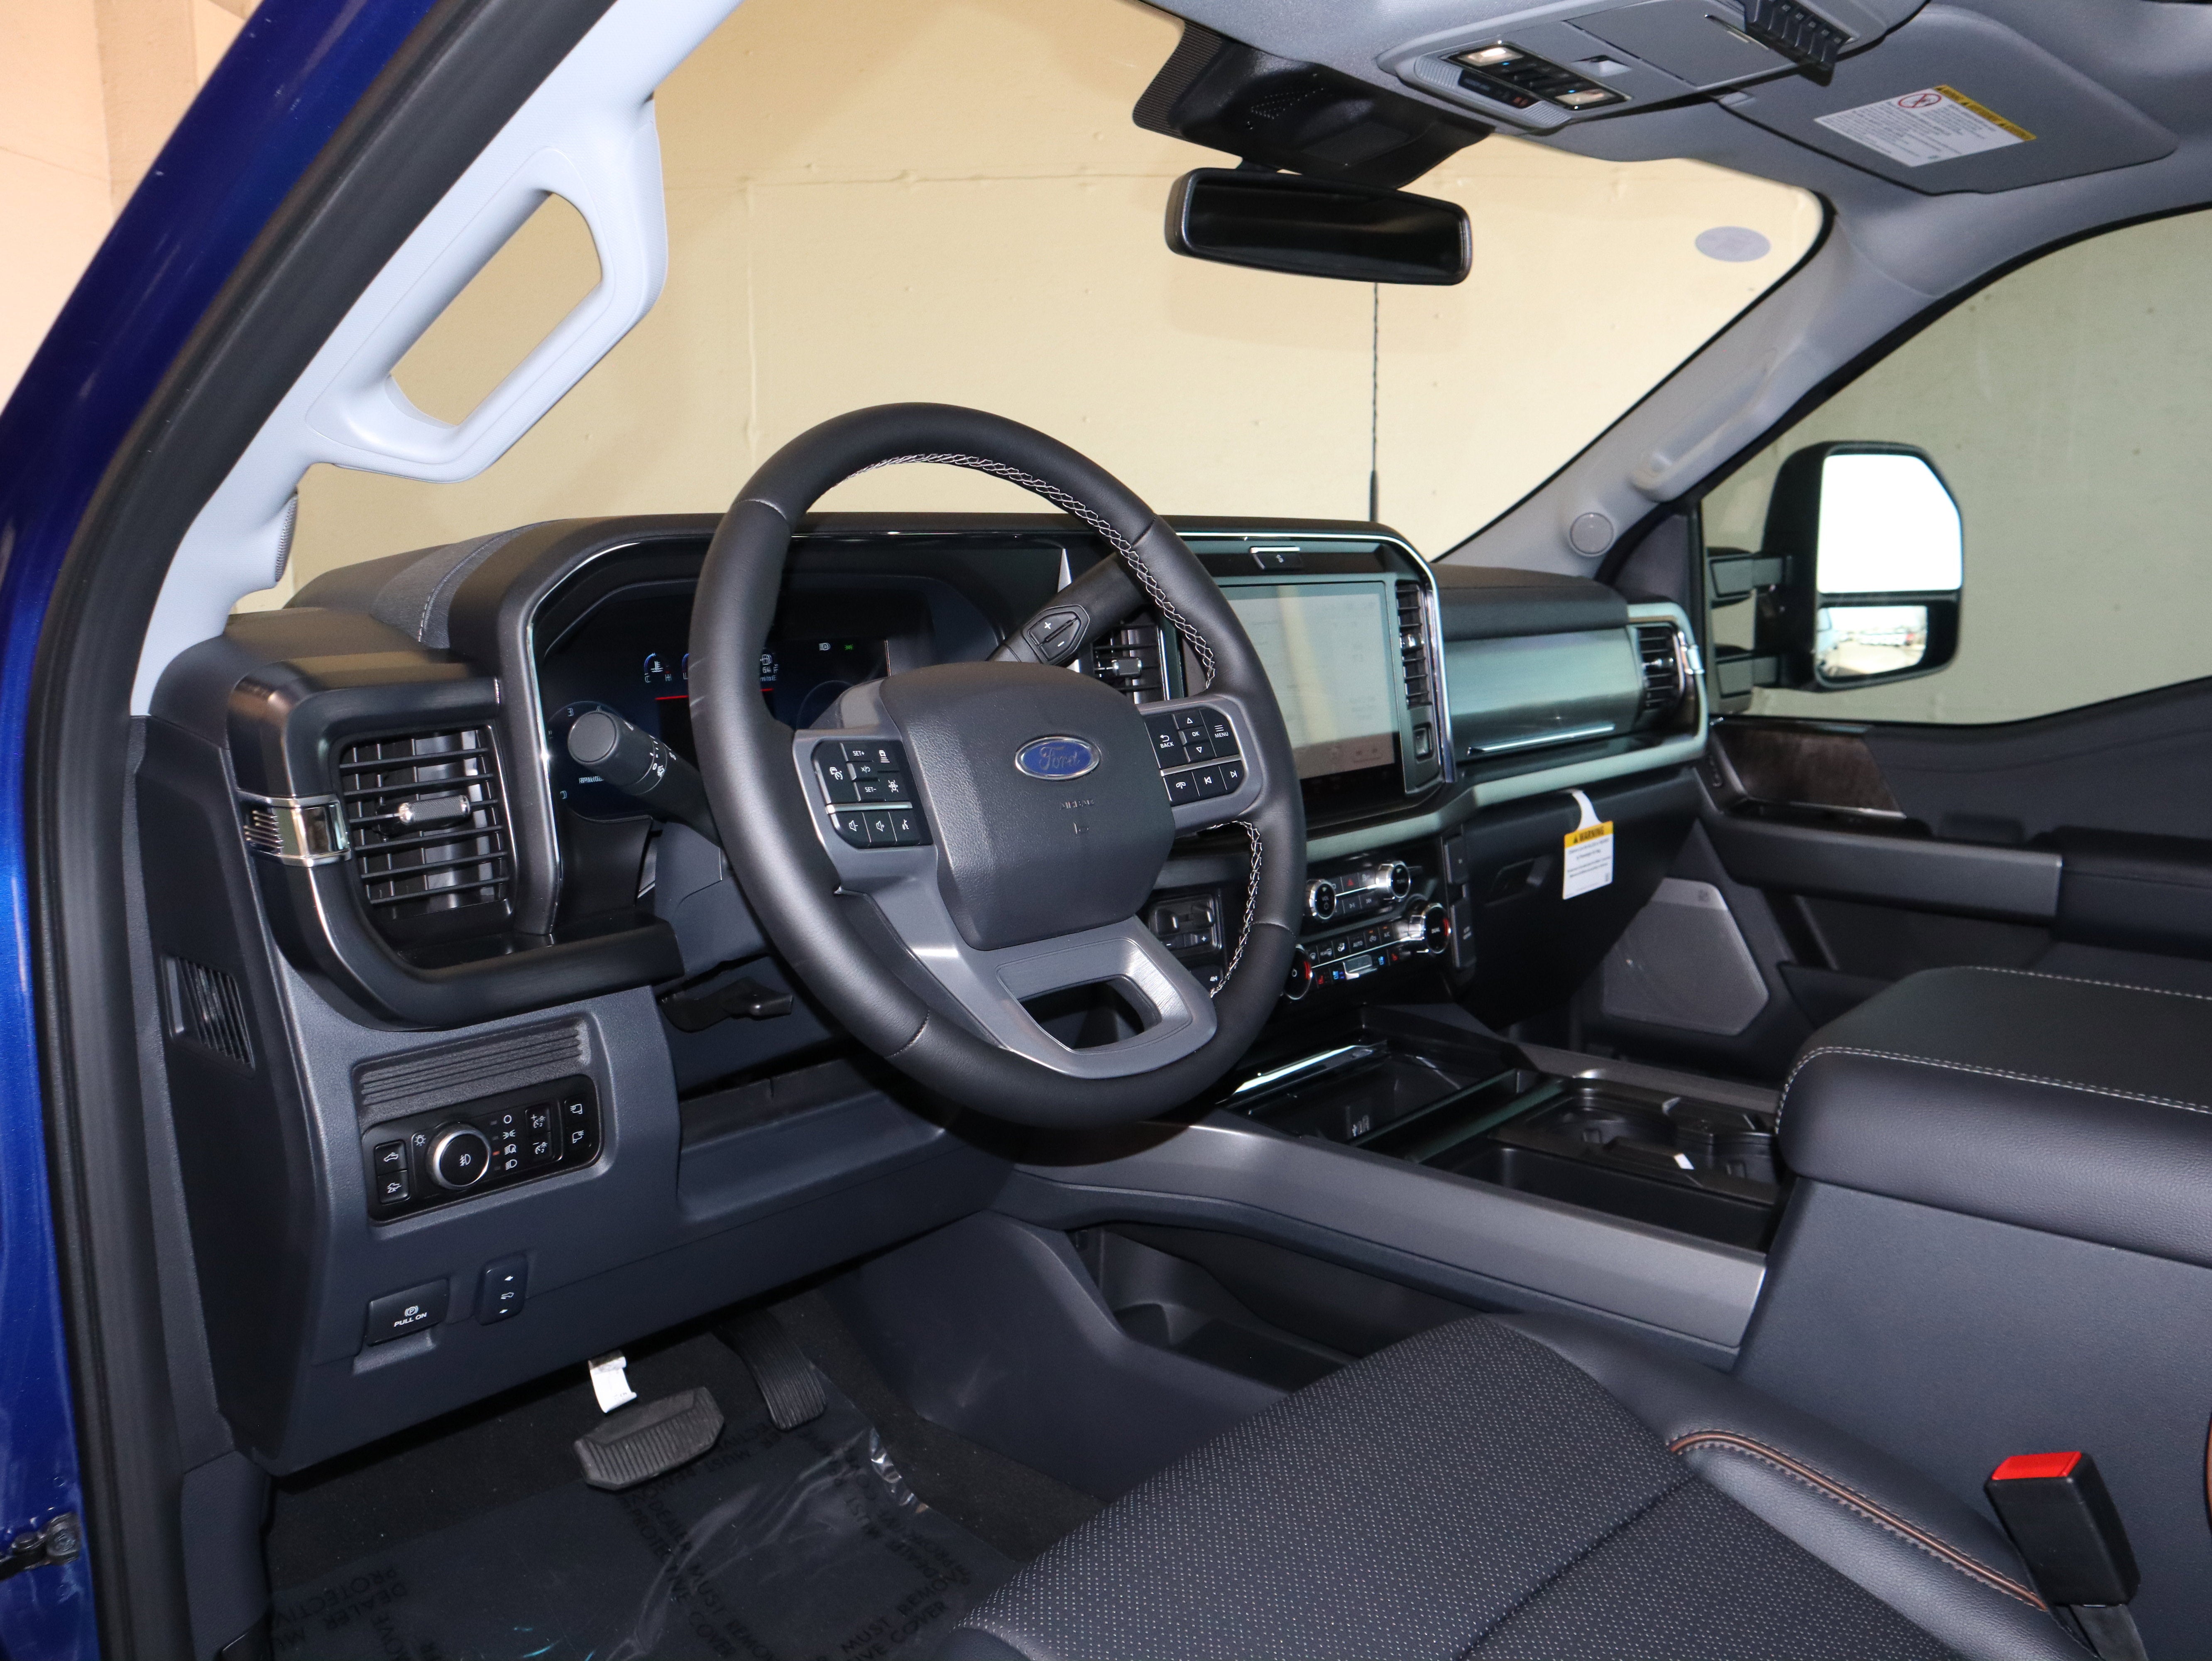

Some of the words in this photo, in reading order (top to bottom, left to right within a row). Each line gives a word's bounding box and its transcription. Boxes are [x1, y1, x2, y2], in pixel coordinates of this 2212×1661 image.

[1039, 746, 1080, 771] Ford
[394, 1317, 414, 1327] PULL
[322, 1582, 408, 1631] DEALER
[890, 1601, 946, 1644] COVER
[841, 1617, 891, 1654] MUST
